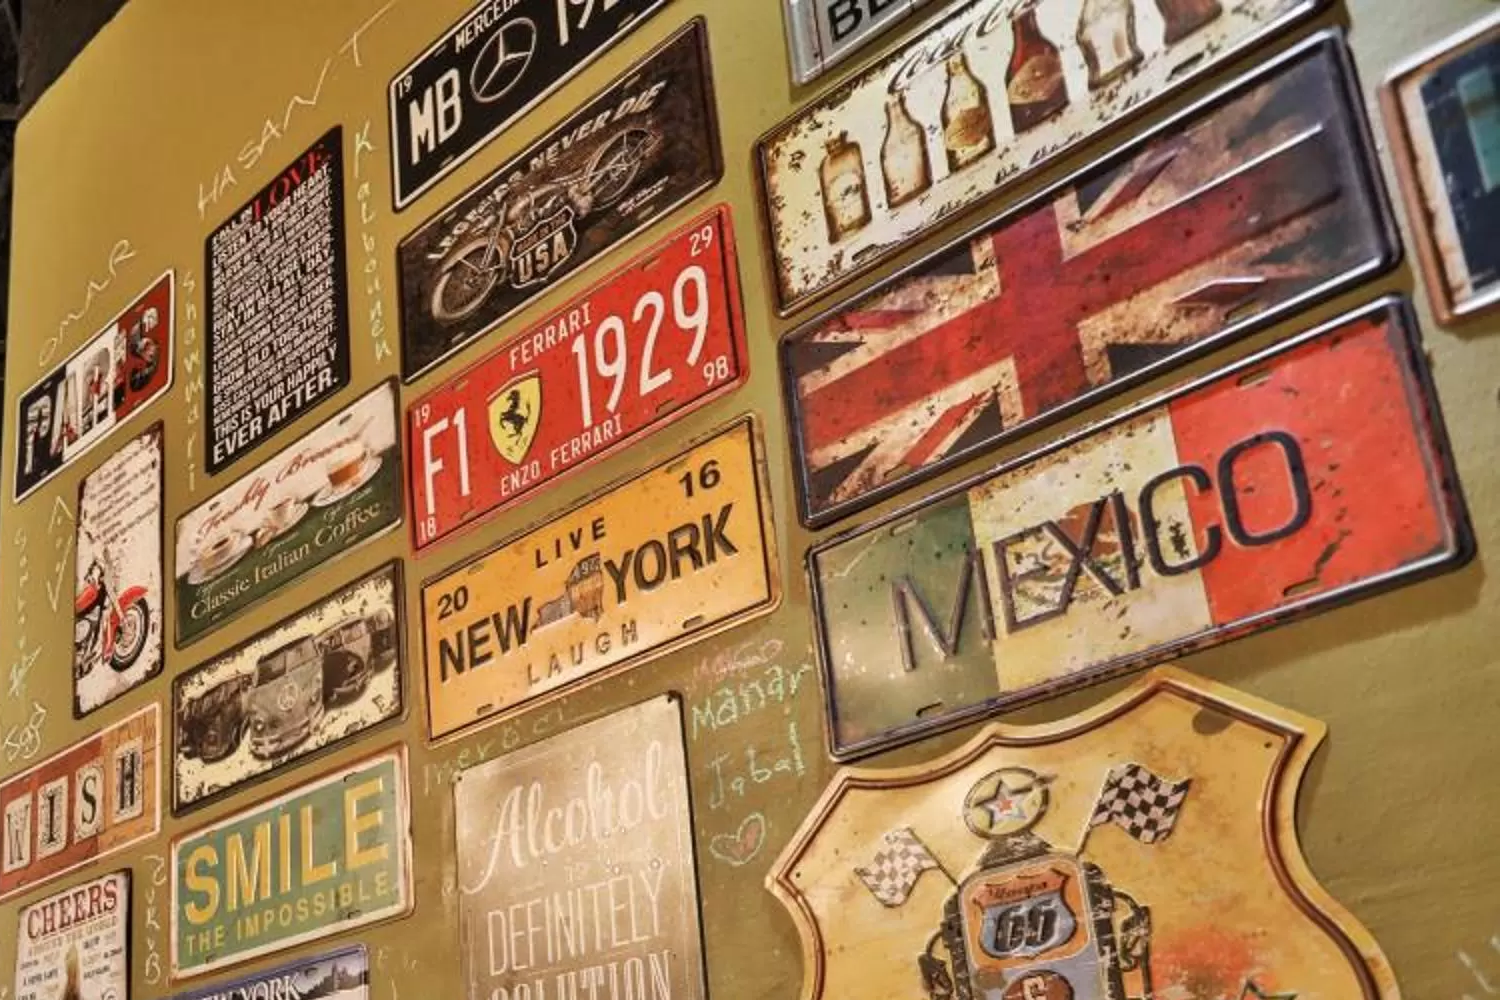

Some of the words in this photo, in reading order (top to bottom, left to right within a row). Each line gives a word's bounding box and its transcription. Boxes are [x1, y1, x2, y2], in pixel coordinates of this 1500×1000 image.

[398, 74, 413, 99] 19
[409, 67, 463, 166] MB
[529, 111, 611, 172] NEVER
[613, 80, 667, 121] DIE
[518, 231, 569, 282] USA
[689, 225, 712, 257] 29
[510, 302, 595, 370] FERRARI
[703, 355, 730, 387] 98
[213, 413, 262, 468] EVER
[267, 358, 338, 429] AFTER.
[214, 413, 238, 445] THIS
[241, 403, 252, 425] IS
[254, 379, 284, 415] YOUR
[286, 341, 337, 393] HAPPILY
[415, 404, 431, 427] 19
[423, 407, 471, 515] F1
[571, 265, 710, 428] 1929
[501, 460, 541, 497] ENZO
[550, 415, 623, 469] FERRARI
[191, 578, 250, 619] Classic
[255, 543, 309, 583] Italian
[315, 502, 381, 548] Coffee
[419, 516, 437, 540] 18
[437, 584, 469, 620] 20
[679, 459, 721, 498] 16
[535, 517, 607, 568] LIVE
[890, 430, 1313, 673] MEXICO
[438, 596, 532, 683] NEW
[603, 504, 738, 605] YORK
[526, 620, 638, 685] LAUGH
[184, 777, 389, 925] SMILE
[460, 739, 669, 896] Alcohol
[27, 877, 117, 941] CHEERS
[185, 925, 225, 956] THE
[236, 871, 389, 941] IMPOSSIBLE
[487, 869, 666, 977] DEFINITELY
